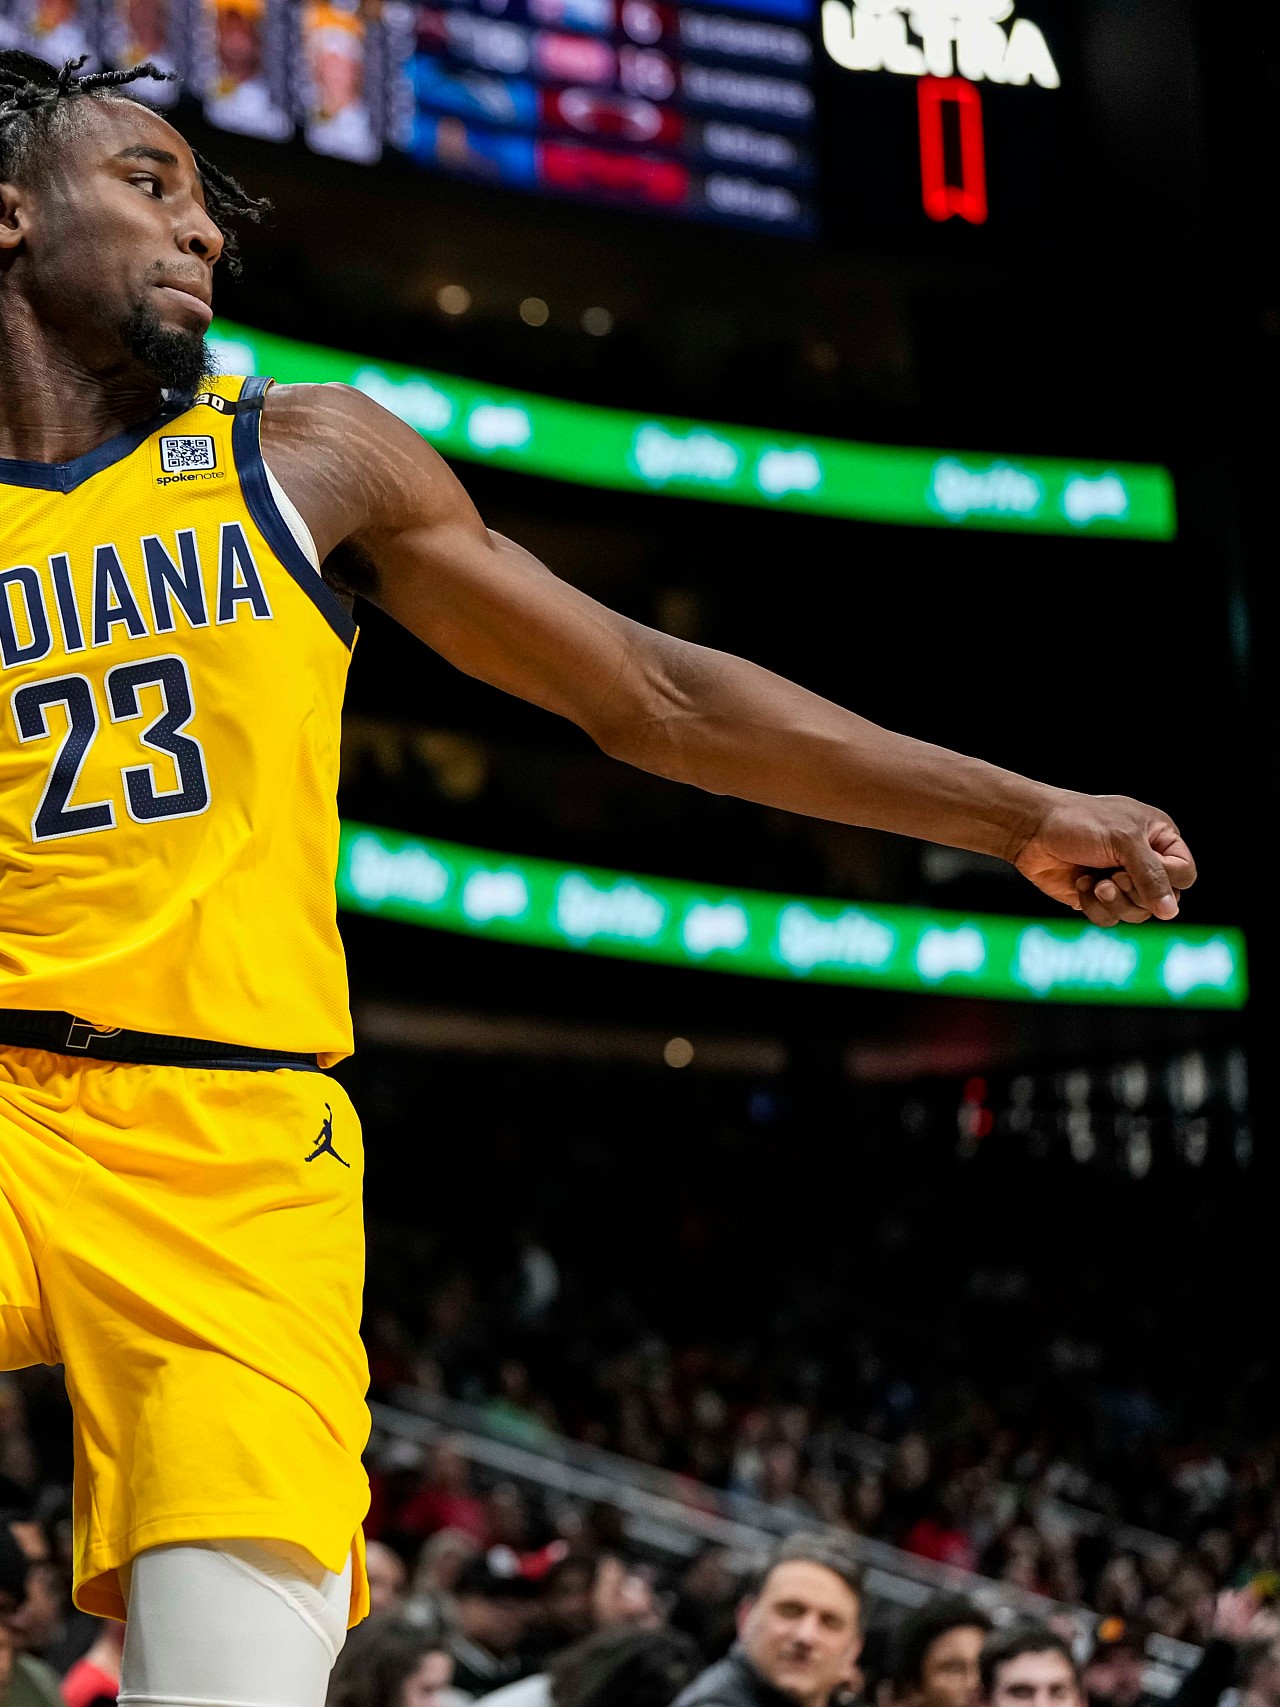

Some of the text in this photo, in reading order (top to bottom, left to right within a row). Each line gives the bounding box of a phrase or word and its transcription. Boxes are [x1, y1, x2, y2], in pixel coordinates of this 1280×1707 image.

[822, 1, 1061, 89] ULTRA
[156, 471, 225, 486] spokenote
[11, 654, 211, 844] 23
